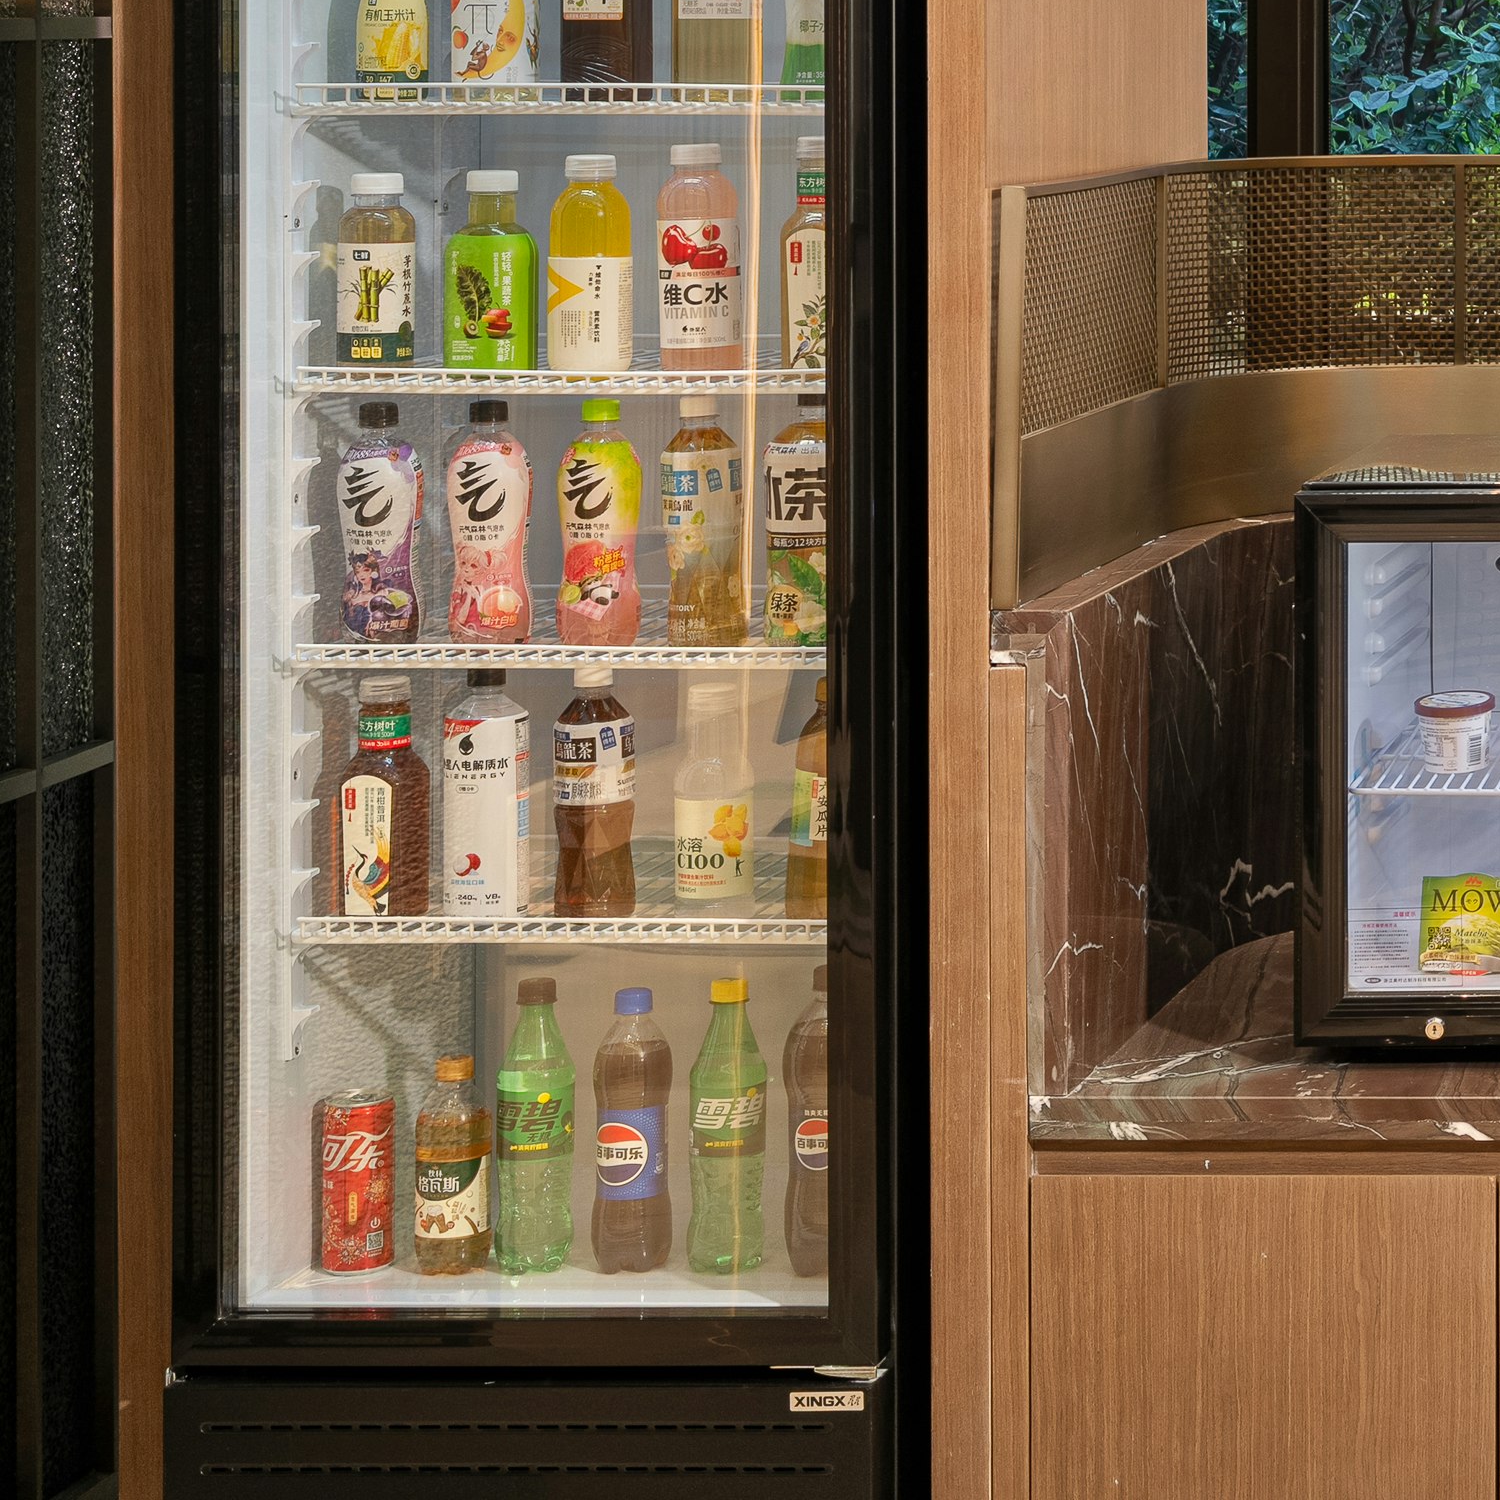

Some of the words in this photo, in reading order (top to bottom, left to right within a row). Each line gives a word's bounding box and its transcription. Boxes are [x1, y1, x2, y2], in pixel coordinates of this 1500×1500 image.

[365, 8, 416, 21] 有机玉米汁
[402, 255, 412, 318] 茅根竹蔗水
[664, 282, 729, 306] 维C水
[664, 306, 718, 319] VITAMIN
[722, 305, 729, 318] C
[459, 525, 486, 533] 元气森林
[566, 523, 592, 531] 元气森林
[771, 592, 799, 612] 绿茶
[444, 757, 509, 772] 星人电解质水
[677, 836, 703, 853] 水溶
[677, 852, 725, 870] C100
[1454, 928, 1488, 937] Matcha
[497, 1099, 563, 1133] 雪碧
[693, 1093, 765, 1130] 雪碧
[597, 1144, 644, 1161] 百事可乐
[418, 1175, 460, 1193] 格瓦斯
[794, 1395, 846, 1408] XINGX
